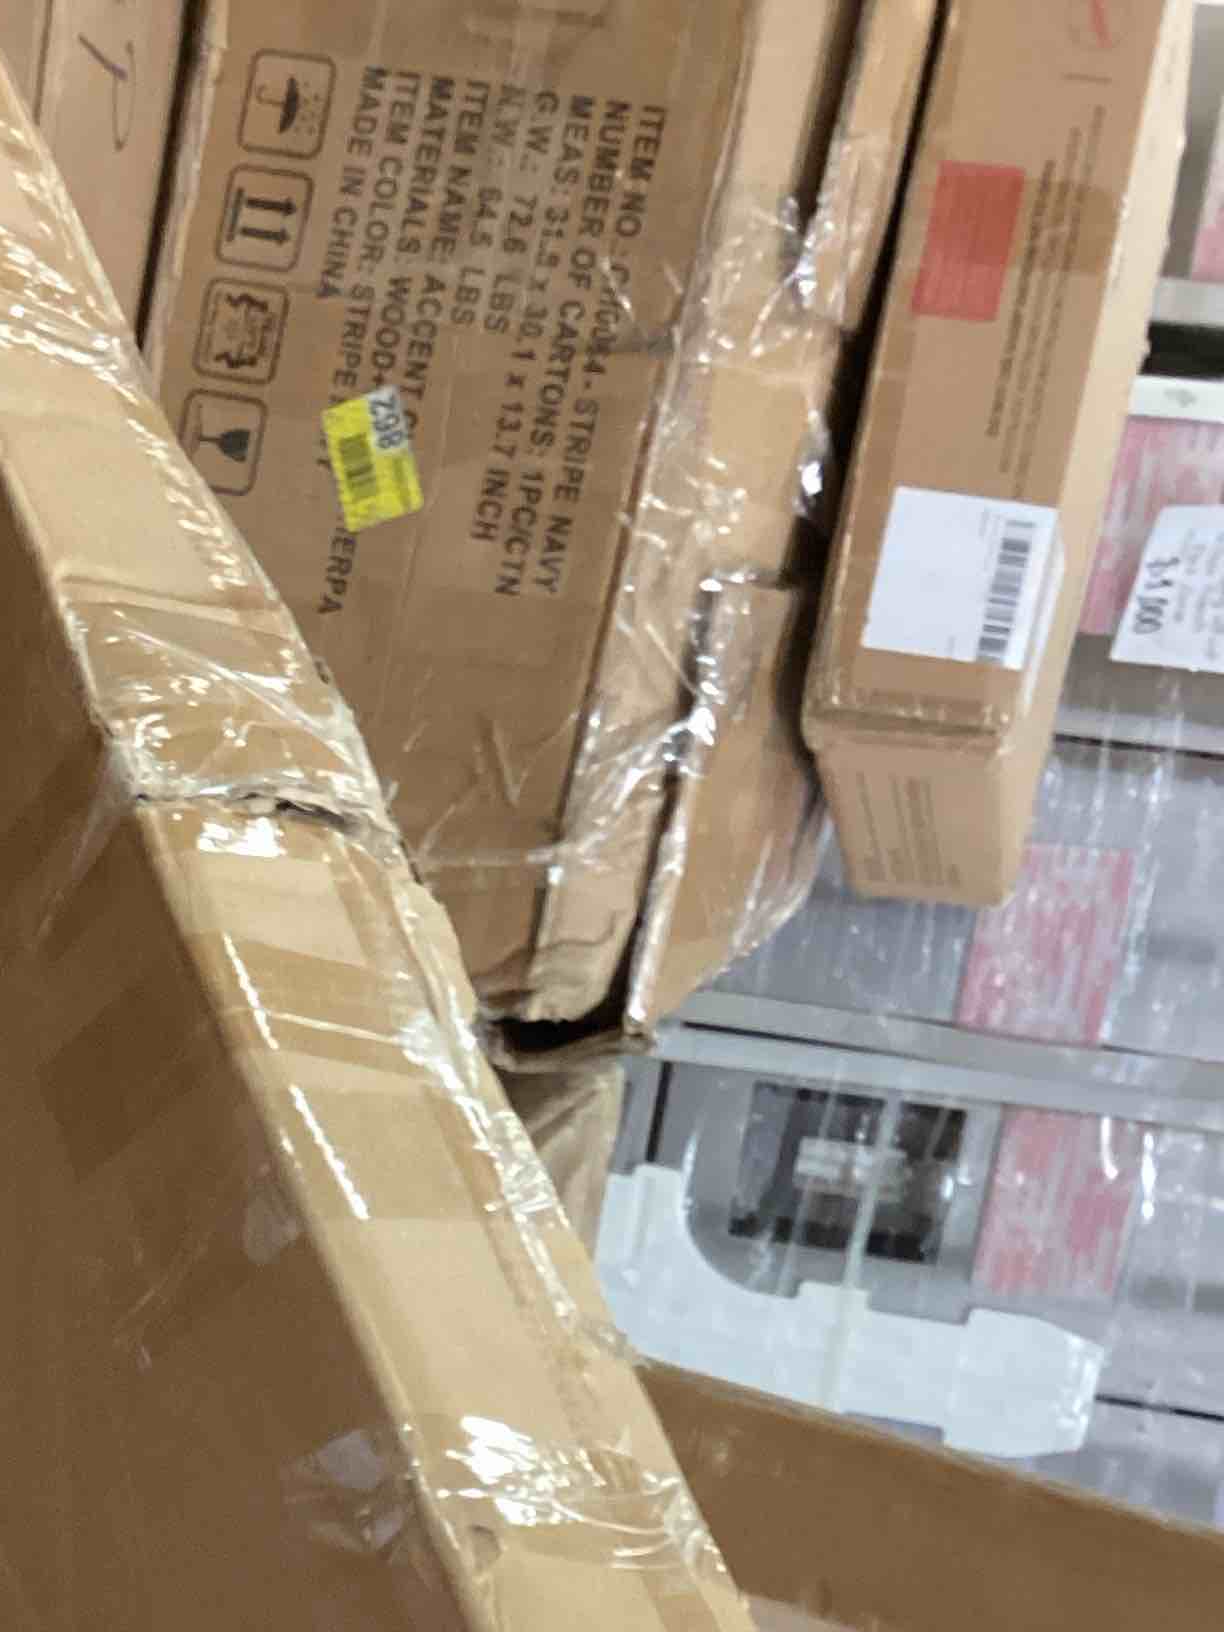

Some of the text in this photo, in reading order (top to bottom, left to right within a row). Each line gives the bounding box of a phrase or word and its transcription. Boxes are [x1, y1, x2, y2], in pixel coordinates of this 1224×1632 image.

[384, 72, 418, 144] ITEM
[454, 81, 487, 154] ITEM
[630, 106, 664, 179] ITEM
[316, 66, 387, 301] MADE IN CHINA
[577, 101, 630, 238] NUMBER
[450, 268, 482, 328] LBS
[569, 247, 595, 289] OF
[329, 283, 373, 386] STRIPE
[399, 276, 446, 398] ACCENT
[484, 275, 515, 335] LBS
[491, 400, 524, 458] 13.7
[471, 468, 511, 543] INCH
[535, 514, 571, 591] NAVY
